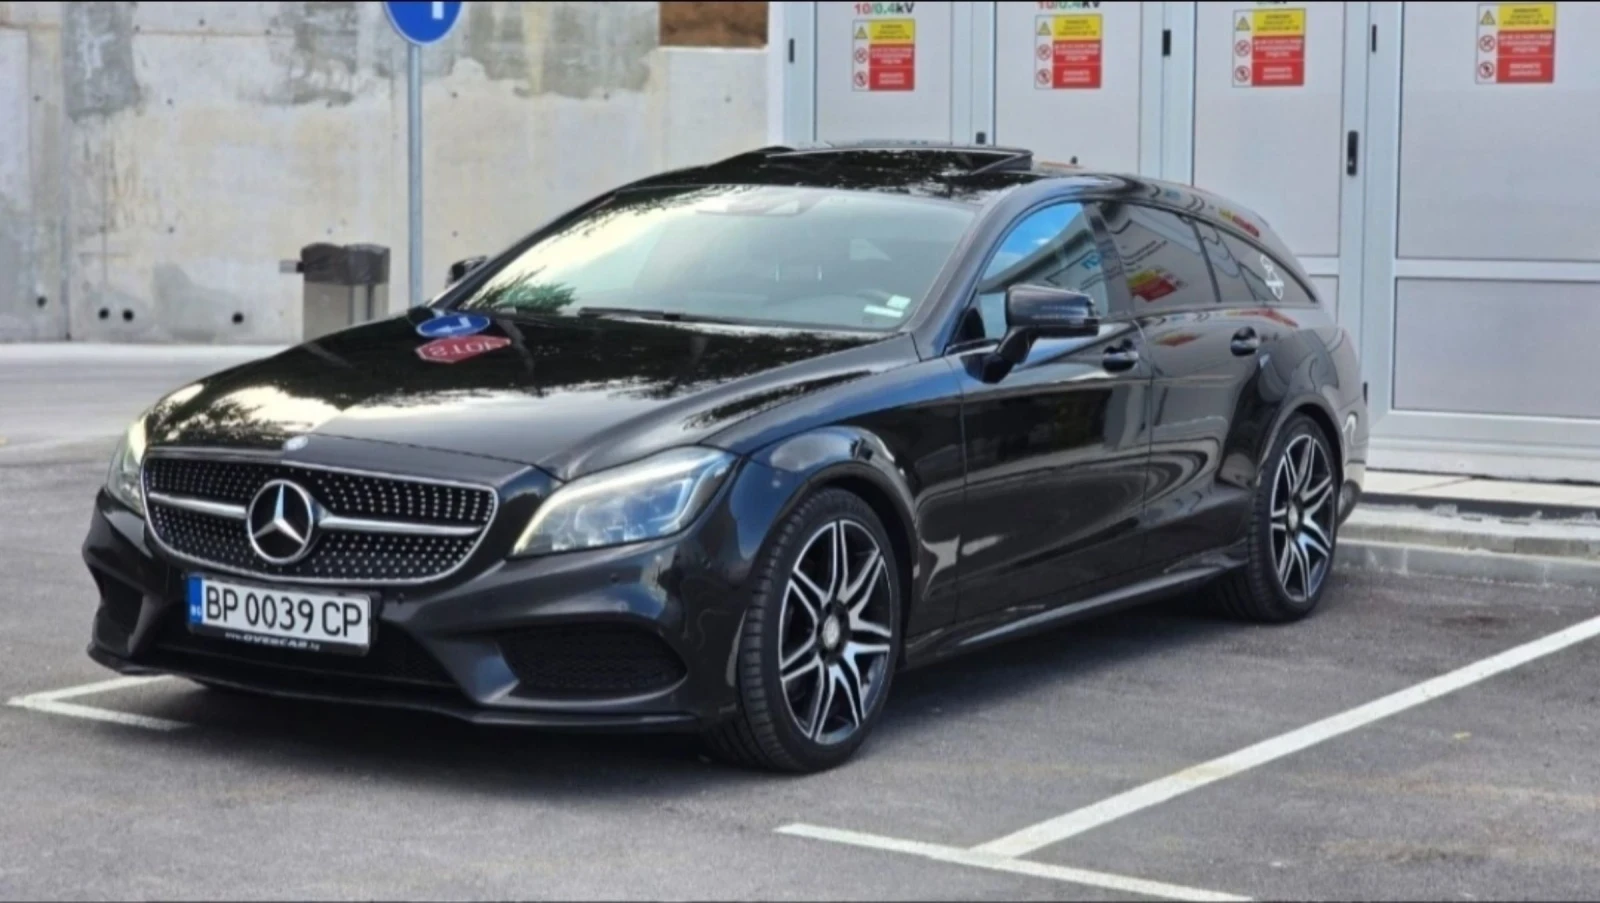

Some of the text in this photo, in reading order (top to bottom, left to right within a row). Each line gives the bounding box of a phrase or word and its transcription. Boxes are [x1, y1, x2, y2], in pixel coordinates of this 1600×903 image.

[854, 2, 915, 14] 10/0.4kV
[205, 585, 362, 637] BP 0039 CP
